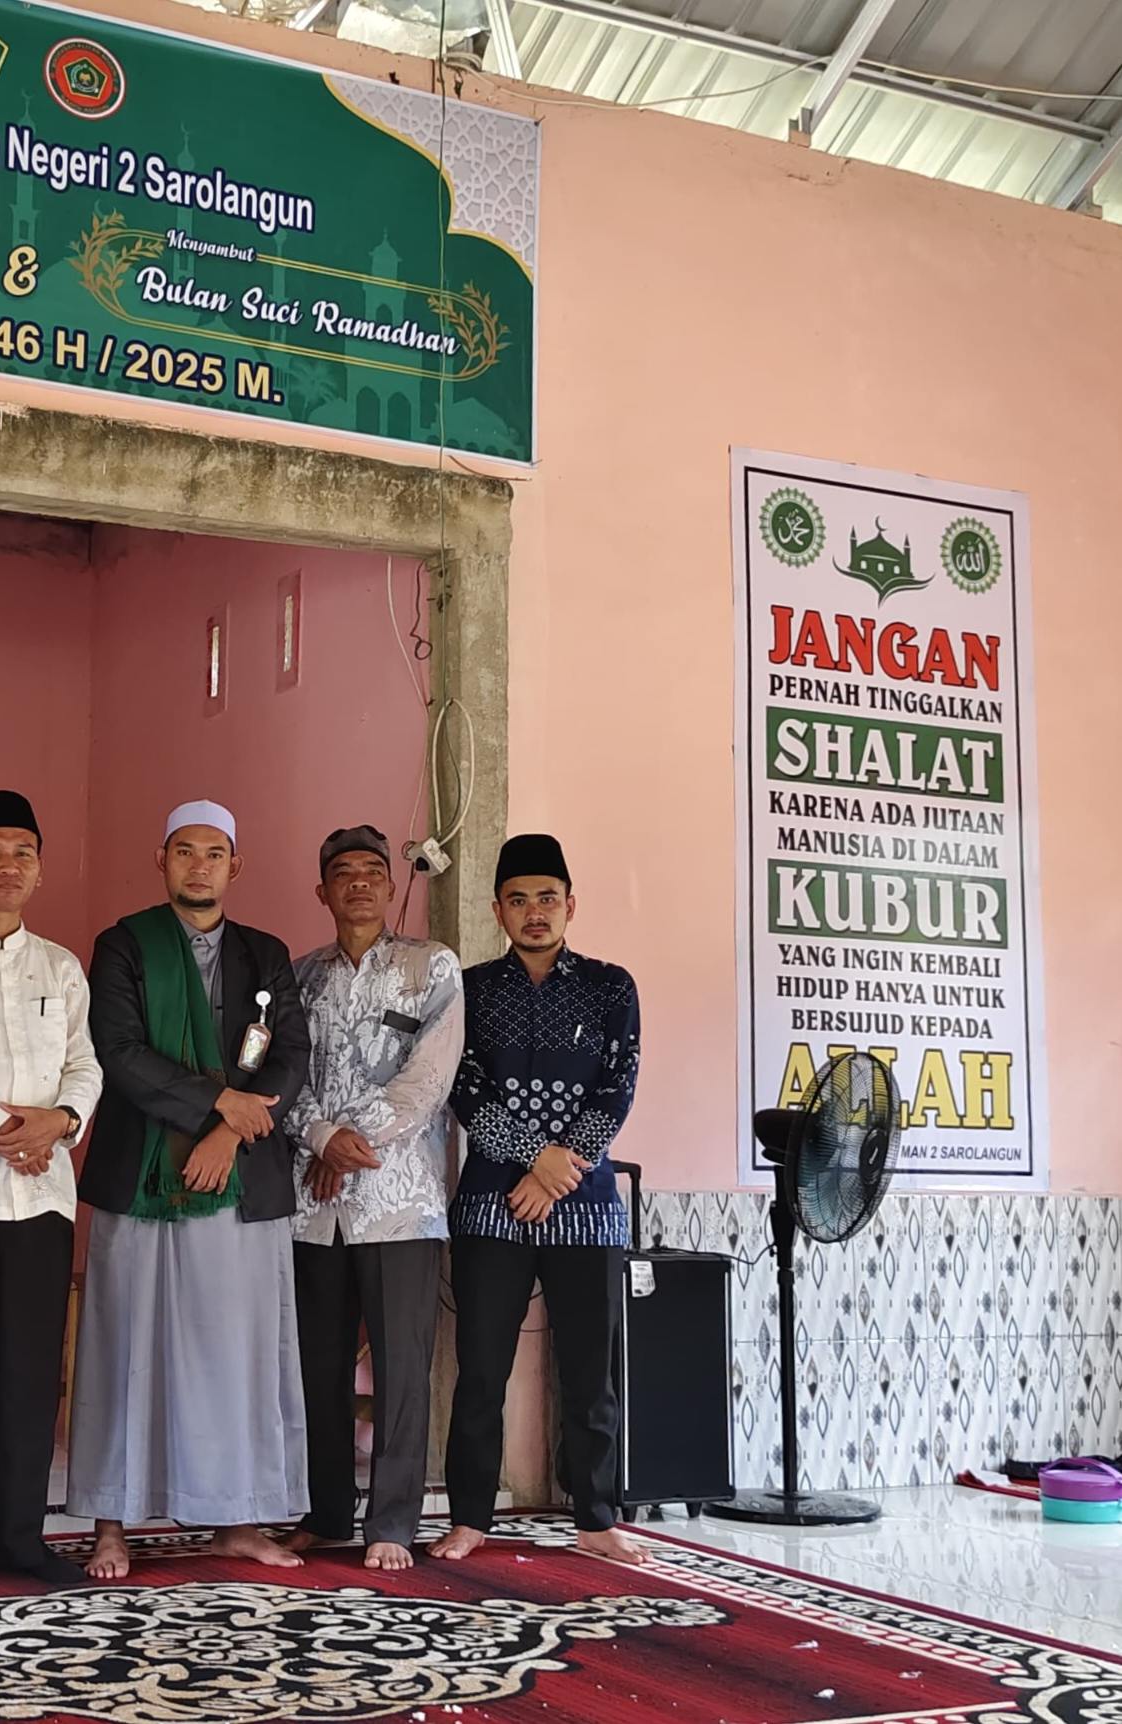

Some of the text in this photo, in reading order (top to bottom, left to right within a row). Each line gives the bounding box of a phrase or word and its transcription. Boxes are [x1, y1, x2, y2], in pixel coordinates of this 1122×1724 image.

[7, 126, 108, 188] Negeri
[118, 157, 136, 193] 2
[145, 157, 313, 233] Sarolangun
[3, 245, 39, 296] &
[167, 229, 256, 262] Menyambut
[135, 267, 460, 355] Bulan Suci Ramadhan
[56, 330, 85, 369] H
[126, 343, 224, 390] 2025
[238, 363, 283, 402] M.
[768, 604, 1000, 691] JANGAN
[769, 673, 1002, 723] PERNAH TINGGALKAN
[773, 718, 994, 796] SHALAT
[769, 791, 1004, 835] KARENA ADA JUTAAN
[777, 827, 999, 868] MANUSIA DI DALAM
[776, 866, 1002, 942] KUBUR
[778, 944, 1001, 978] YANG INGIN KEMBALI
[777, 976, 1006, 1009] HIDUP HANYA UNTUK
[791, 1009, 993, 1040] BERSUJUD KEPADA
[901, 1146, 1022, 1161] MAN 2 SAROLANGUN
